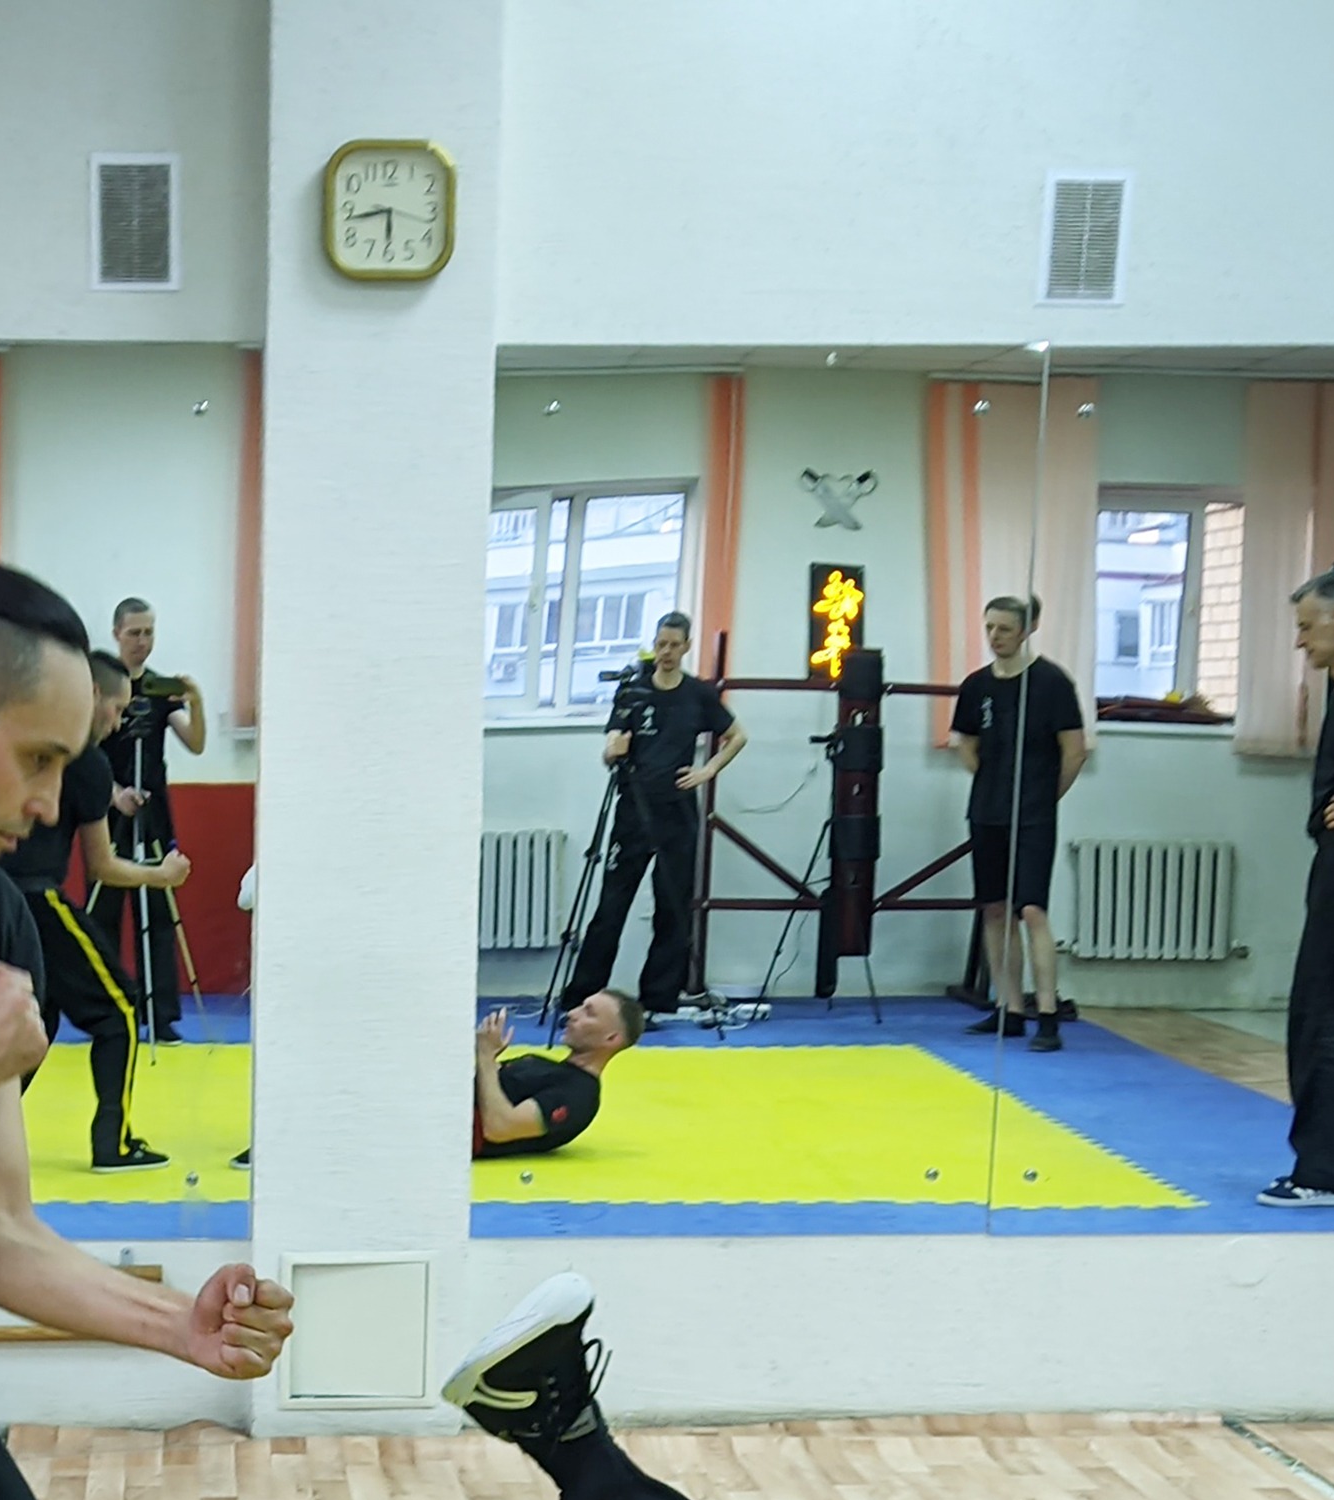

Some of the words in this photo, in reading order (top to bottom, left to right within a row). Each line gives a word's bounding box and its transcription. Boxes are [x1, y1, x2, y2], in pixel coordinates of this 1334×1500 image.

[364, 162, 377, 181] 11
[382, 159, 398, 180] 12
[424, 173, 436, 195] 2
[341, 200, 355, 221] 9
[424, 201, 438, 223] 3
[343, 227, 357, 248] 8
[420, 227, 433, 248] 4
[364, 238, 376, 259] 7
[382, 240, 395, 262] 6
[402, 239, 415, 261] 5
